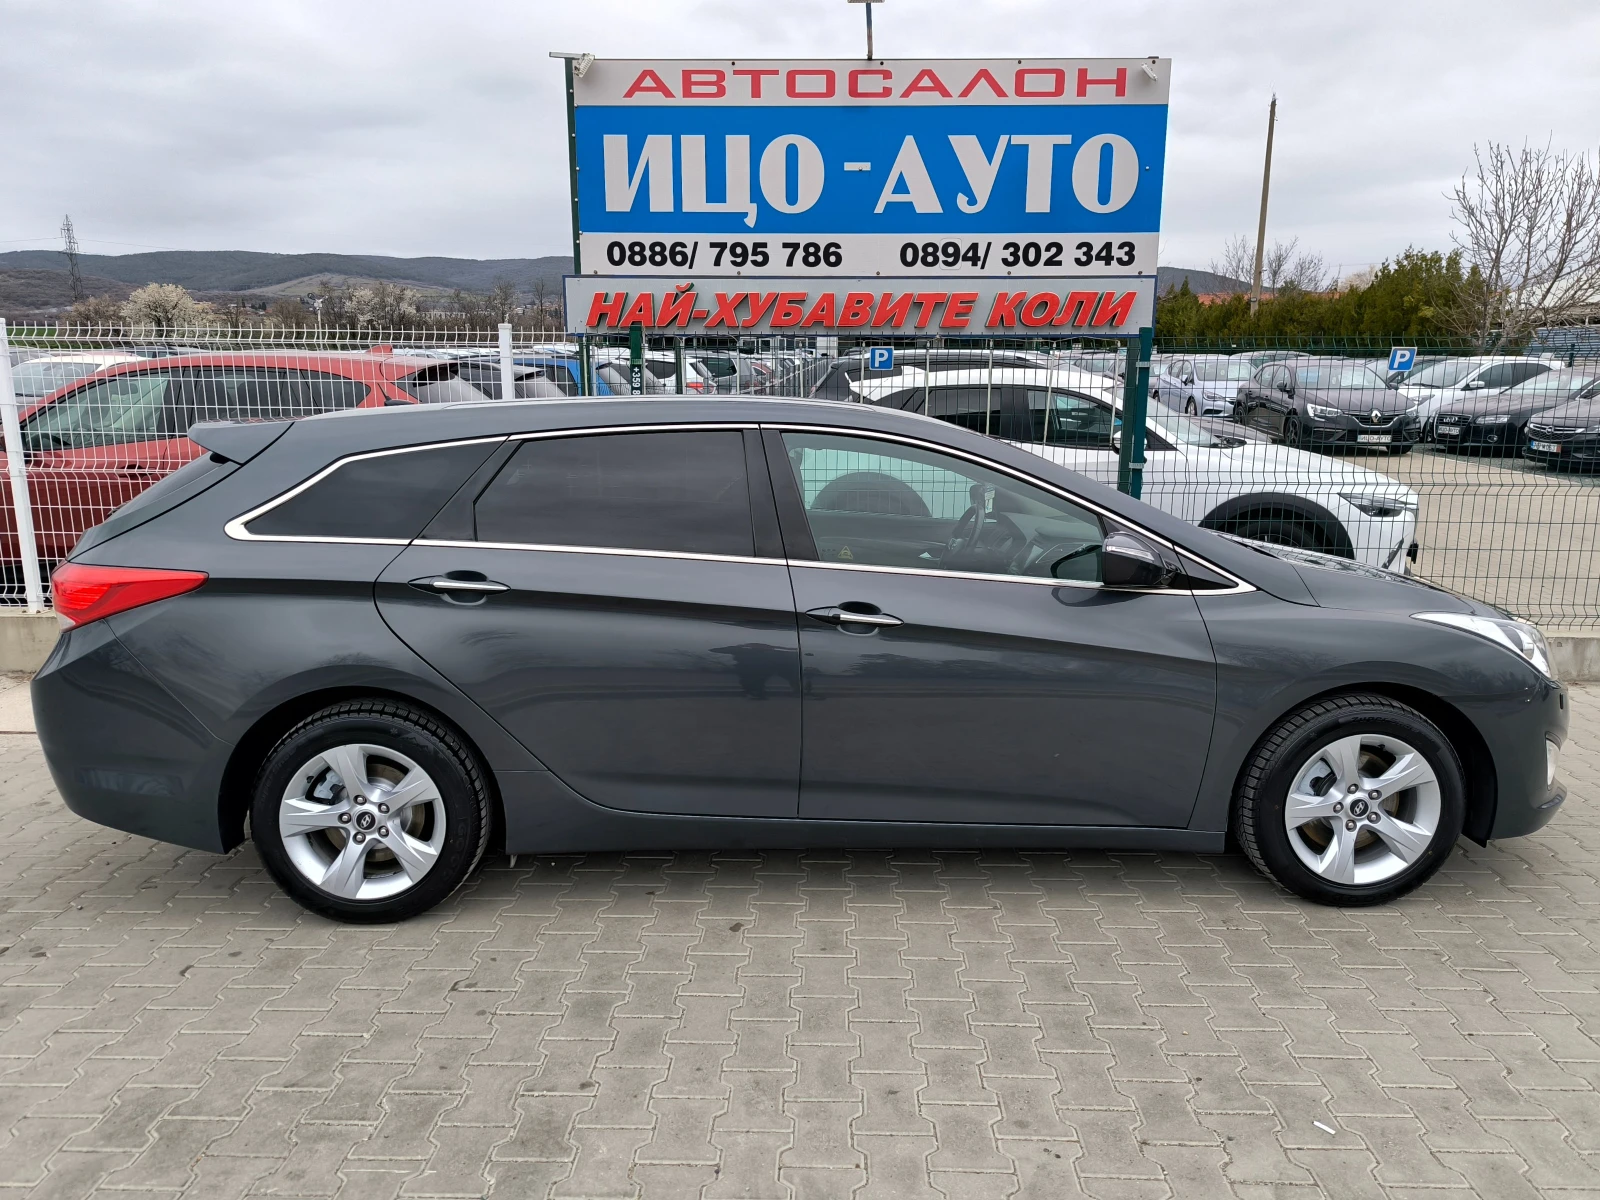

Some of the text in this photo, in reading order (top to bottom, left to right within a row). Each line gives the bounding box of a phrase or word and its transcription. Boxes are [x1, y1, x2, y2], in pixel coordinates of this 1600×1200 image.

[624, 67, 1127, 98] АВТОСАЛОН
[606, 241, 843, 269] 0886/ 795 786
[899, 241, 1136, 269] 0894/ 302 343
[585, 282, 1138, 328] НАЙ-ХУБАВИТЕ КОЛИ
[874, 349, 889, 368] P
[1393, 350, 1411, 369] P
[632, 367, 641, 387] +359
